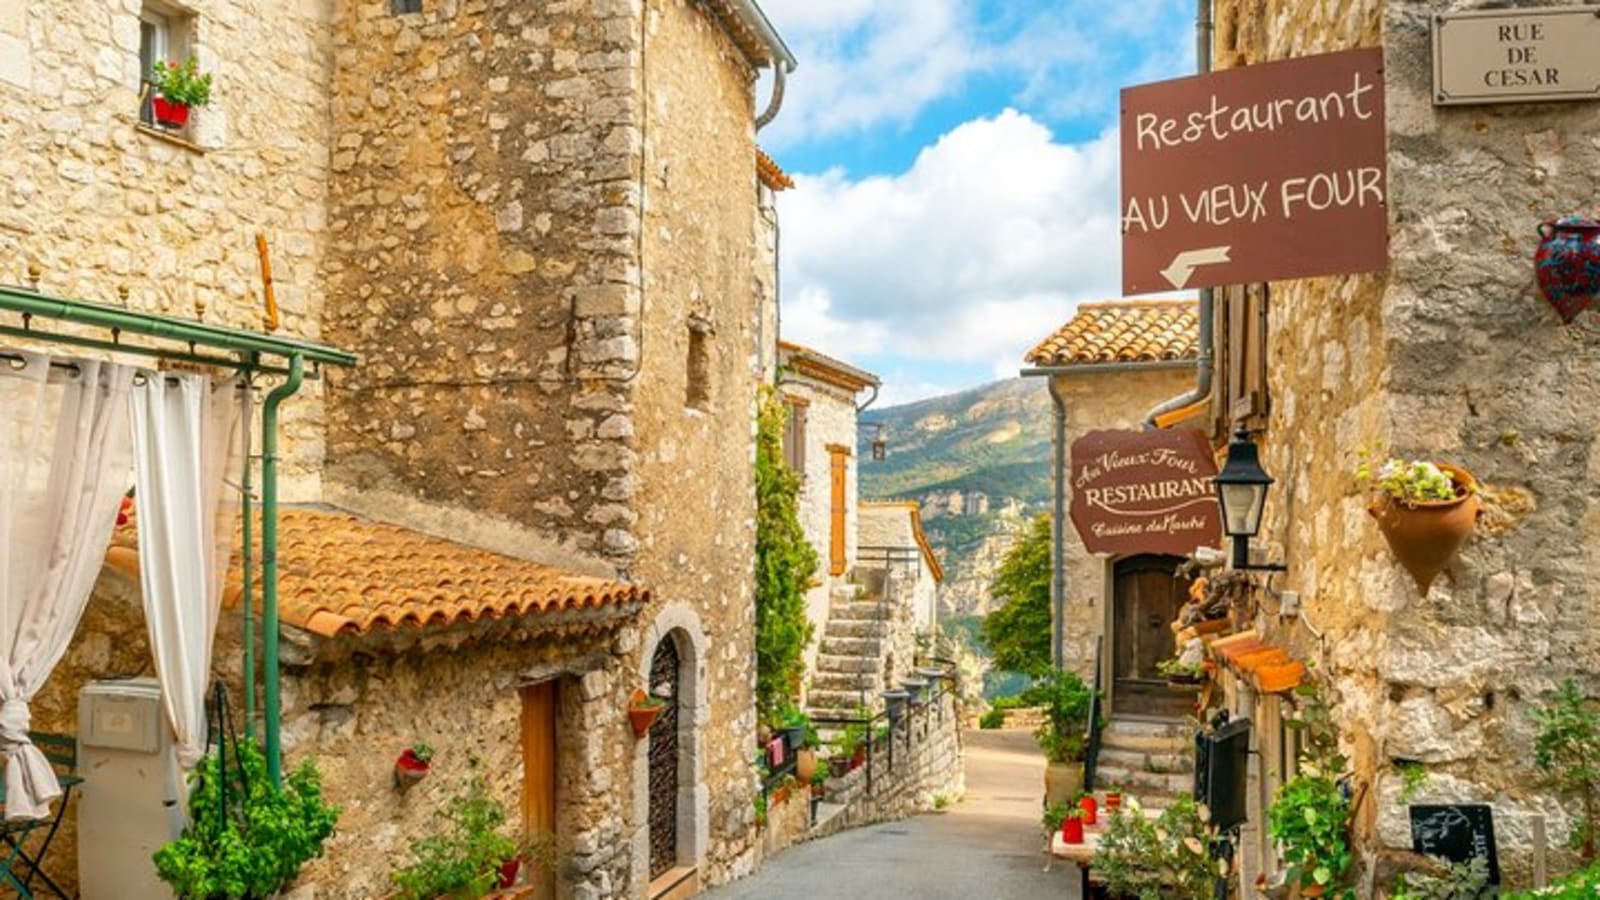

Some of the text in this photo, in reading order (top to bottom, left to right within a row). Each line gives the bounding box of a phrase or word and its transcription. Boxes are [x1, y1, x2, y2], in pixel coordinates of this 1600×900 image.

[1498, 23, 1545, 41] RUE
[1508, 46, 1538, 65] DE
[1483, 67, 1560, 88] CESAR
[1136, 72, 1373, 150] Restaurant
[1121, 167, 1384, 233] AU VIEUX FOUR
[1075, 448, 1198, 489] Au Vieux Four
[1085, 474, 1217, 506] RESTAURANT
